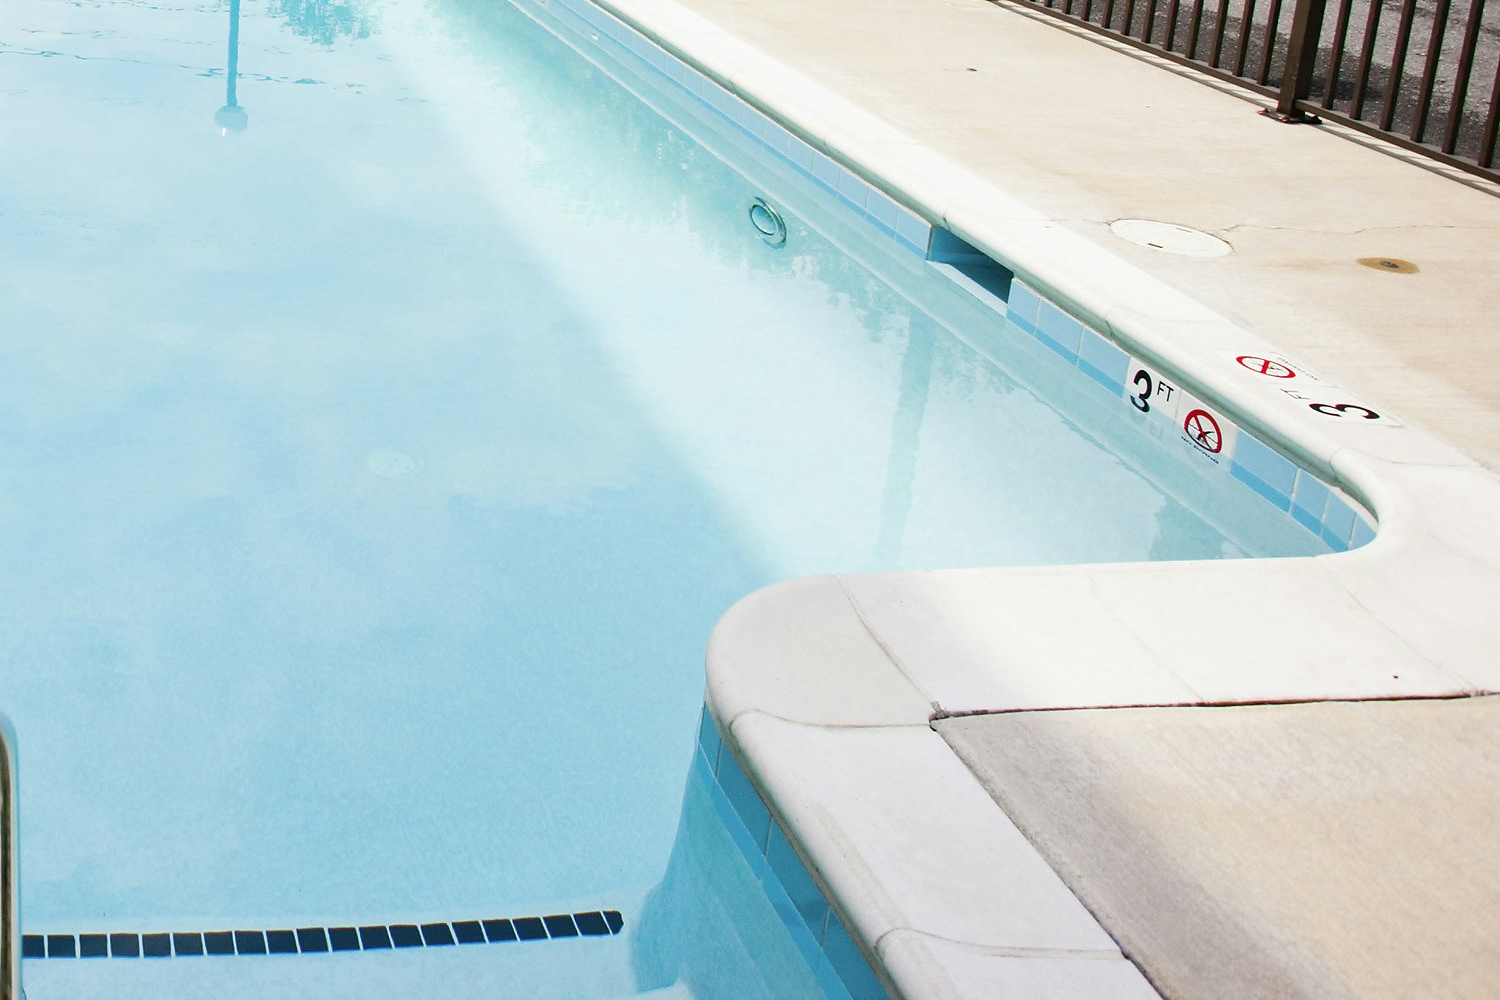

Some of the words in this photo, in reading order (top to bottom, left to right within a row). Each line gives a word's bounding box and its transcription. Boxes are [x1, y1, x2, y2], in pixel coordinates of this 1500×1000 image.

[1130, 369, 1153, 413] 3
[1156, 380, 1175, 403] FT
[1308, 403, 1381, 420] 3
